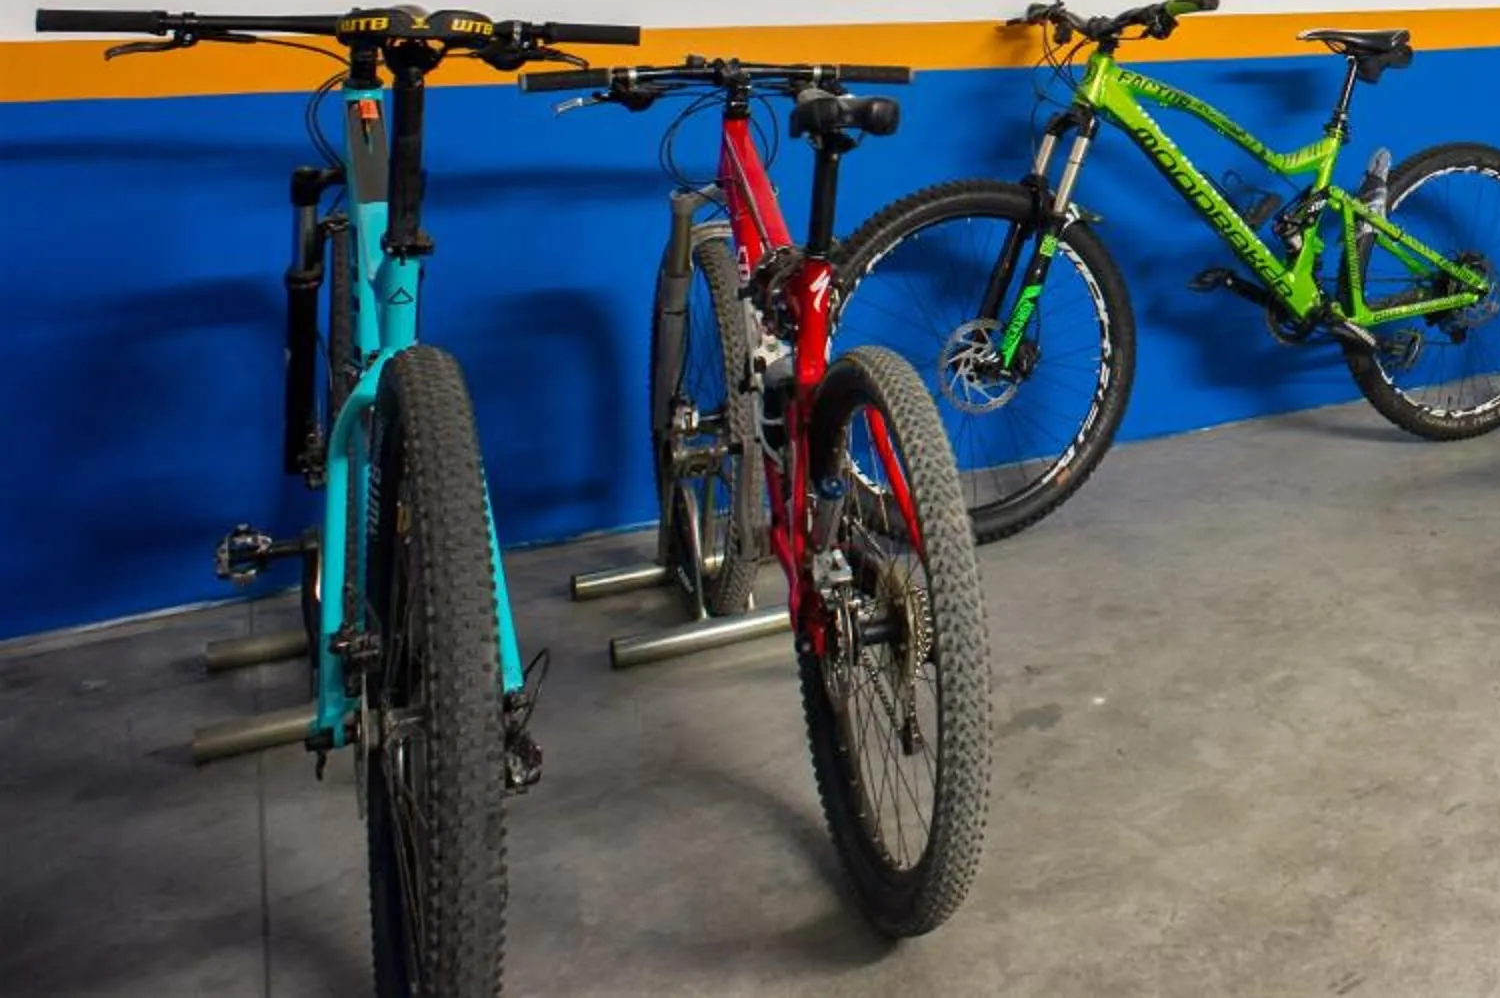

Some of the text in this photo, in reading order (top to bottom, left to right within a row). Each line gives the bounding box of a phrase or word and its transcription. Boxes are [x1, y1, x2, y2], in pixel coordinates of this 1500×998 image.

[340, 17, 389, 32] WTB
[451, 18, 494, 35] WTB
[1135, 127, 1293, 297] MONDRAKER
